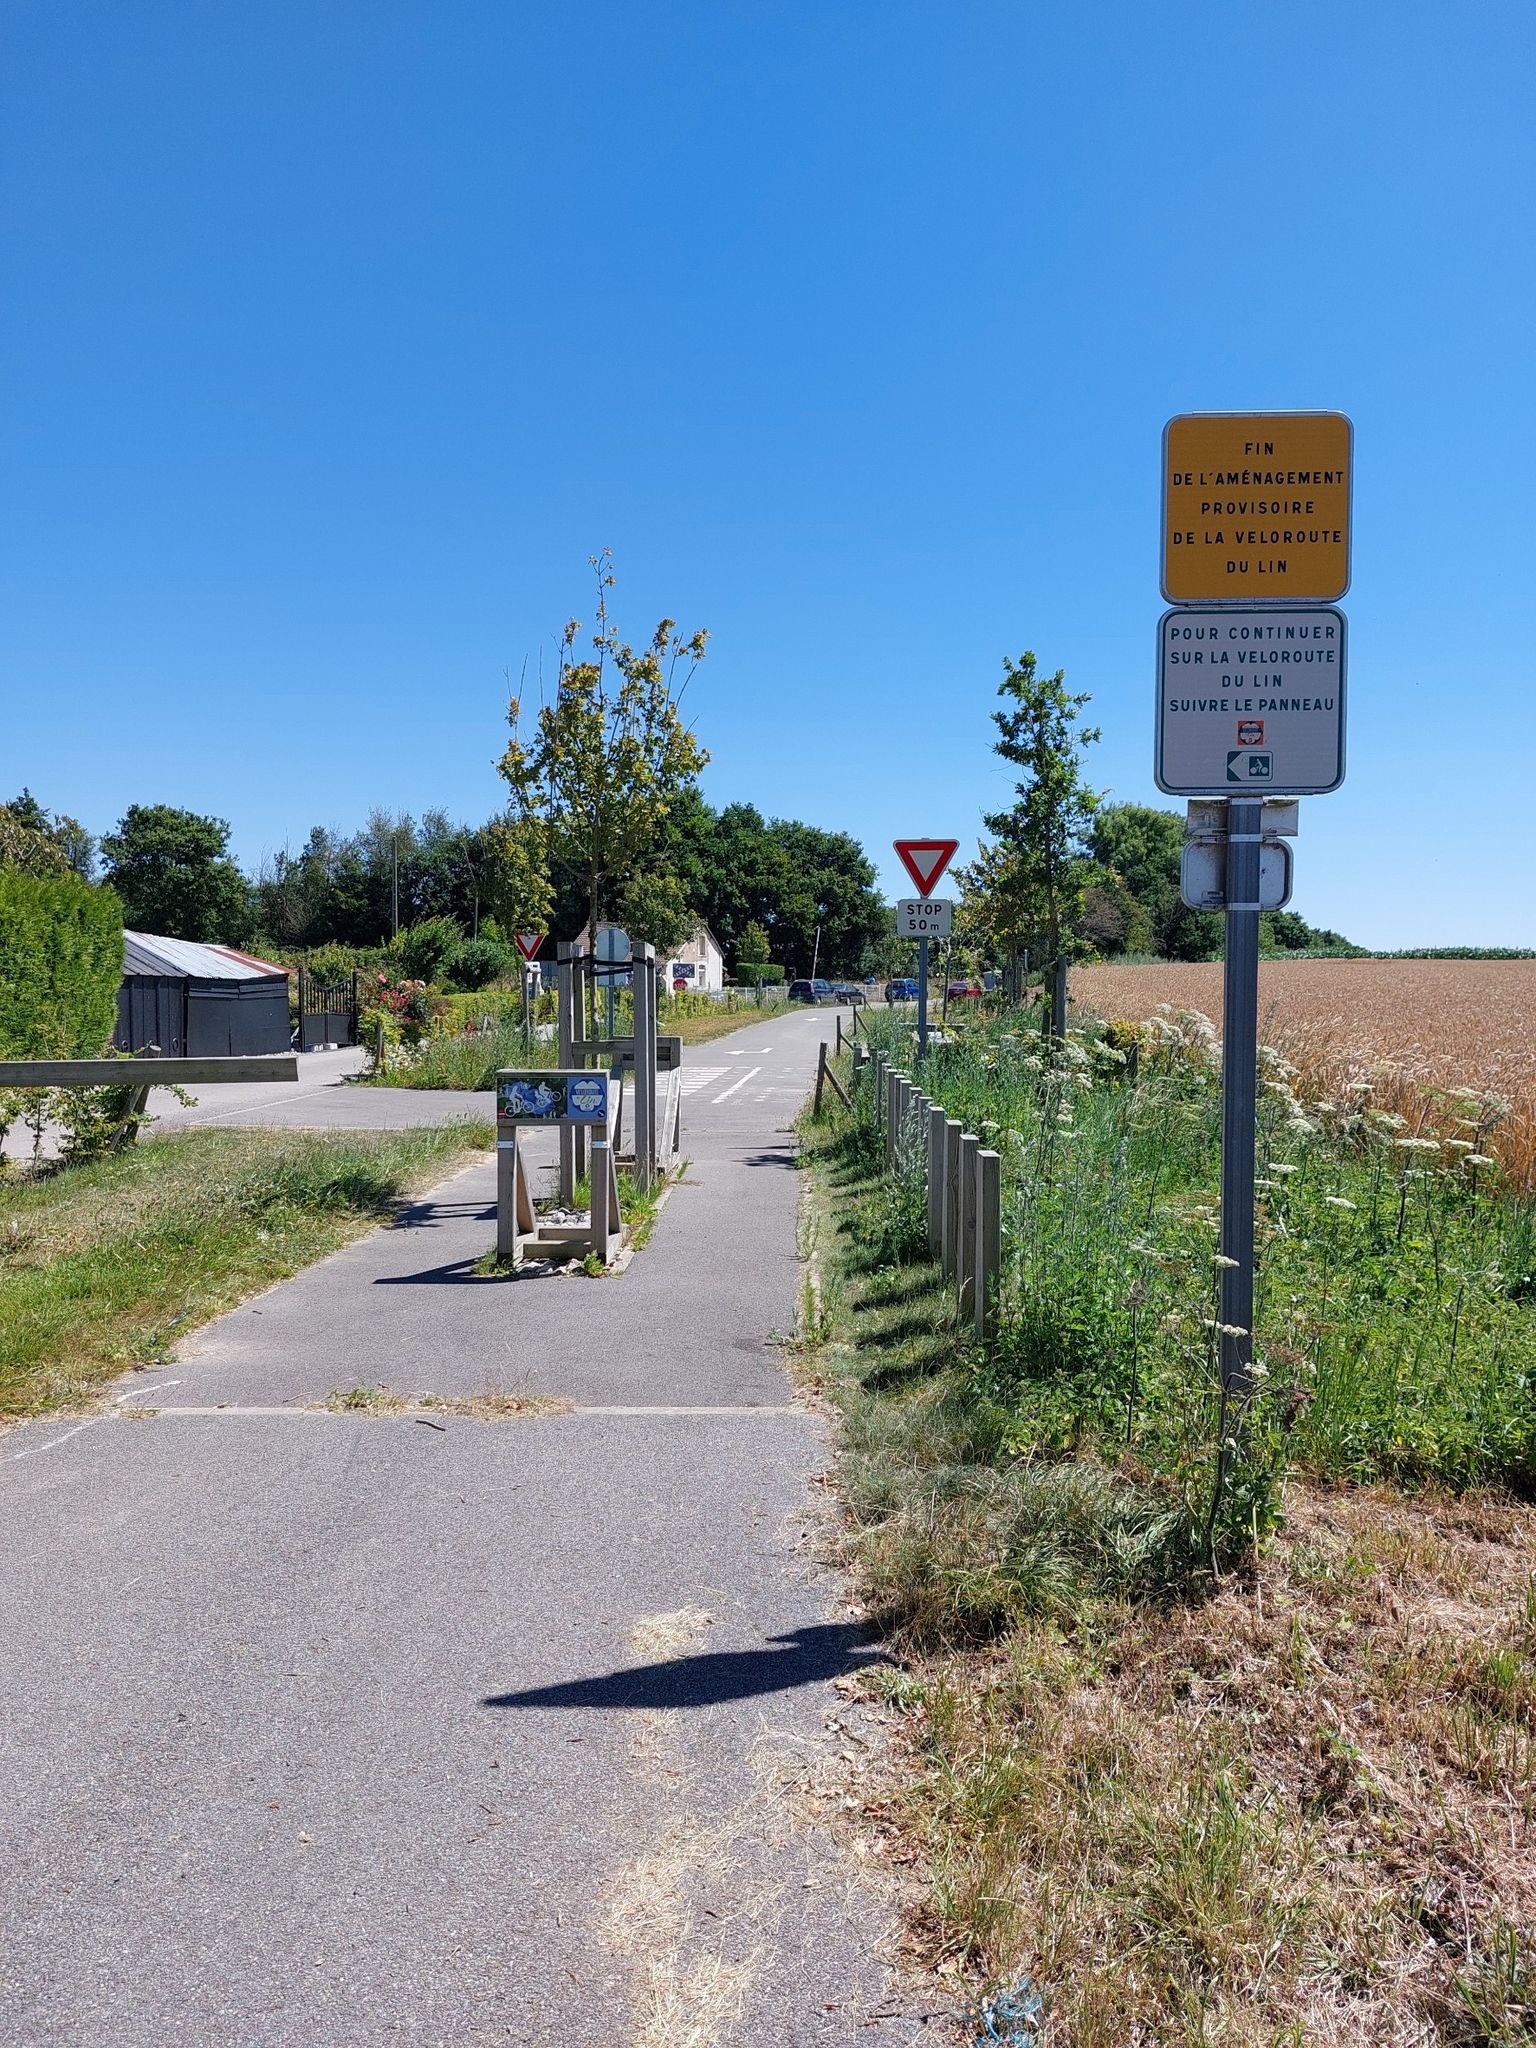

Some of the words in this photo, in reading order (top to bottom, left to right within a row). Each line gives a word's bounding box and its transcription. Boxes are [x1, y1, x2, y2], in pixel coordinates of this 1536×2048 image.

[1245, 443, 1274, 455] FIN
[1173, 473, 1193, 485] DE
[1202, 502, 1314, 514] PROVISOIRE
[1174, 532, 1194, 544] DE
[1205, 532, 1224, 544] LA
[1236, 531, 1341, 543] VELOROUTE
[1227, 561, 1248, 573] DU
[1258, 560, 1287, 572] LIN
[1171, 628, 1218, 640] POUR
[1229, 627, 1335, 639] CONTINUER
[1170, 652, 1203, 664] SUR
[1211, 652, 1229, 664] LA
[1238, 650, 1335, 663] VELOROUTE
[1222, 676, 1244, 687] DU
[1254, 675, 1282, 687] LIN
[1170, 700, 1228, 712] SUIVRE
[1235, 699, 1252, 711] LE
[1259, 698, 1333, 711] PANNEAU
[907, 904, 942, 915] STOP
[909, 920, 927, 930] 50
